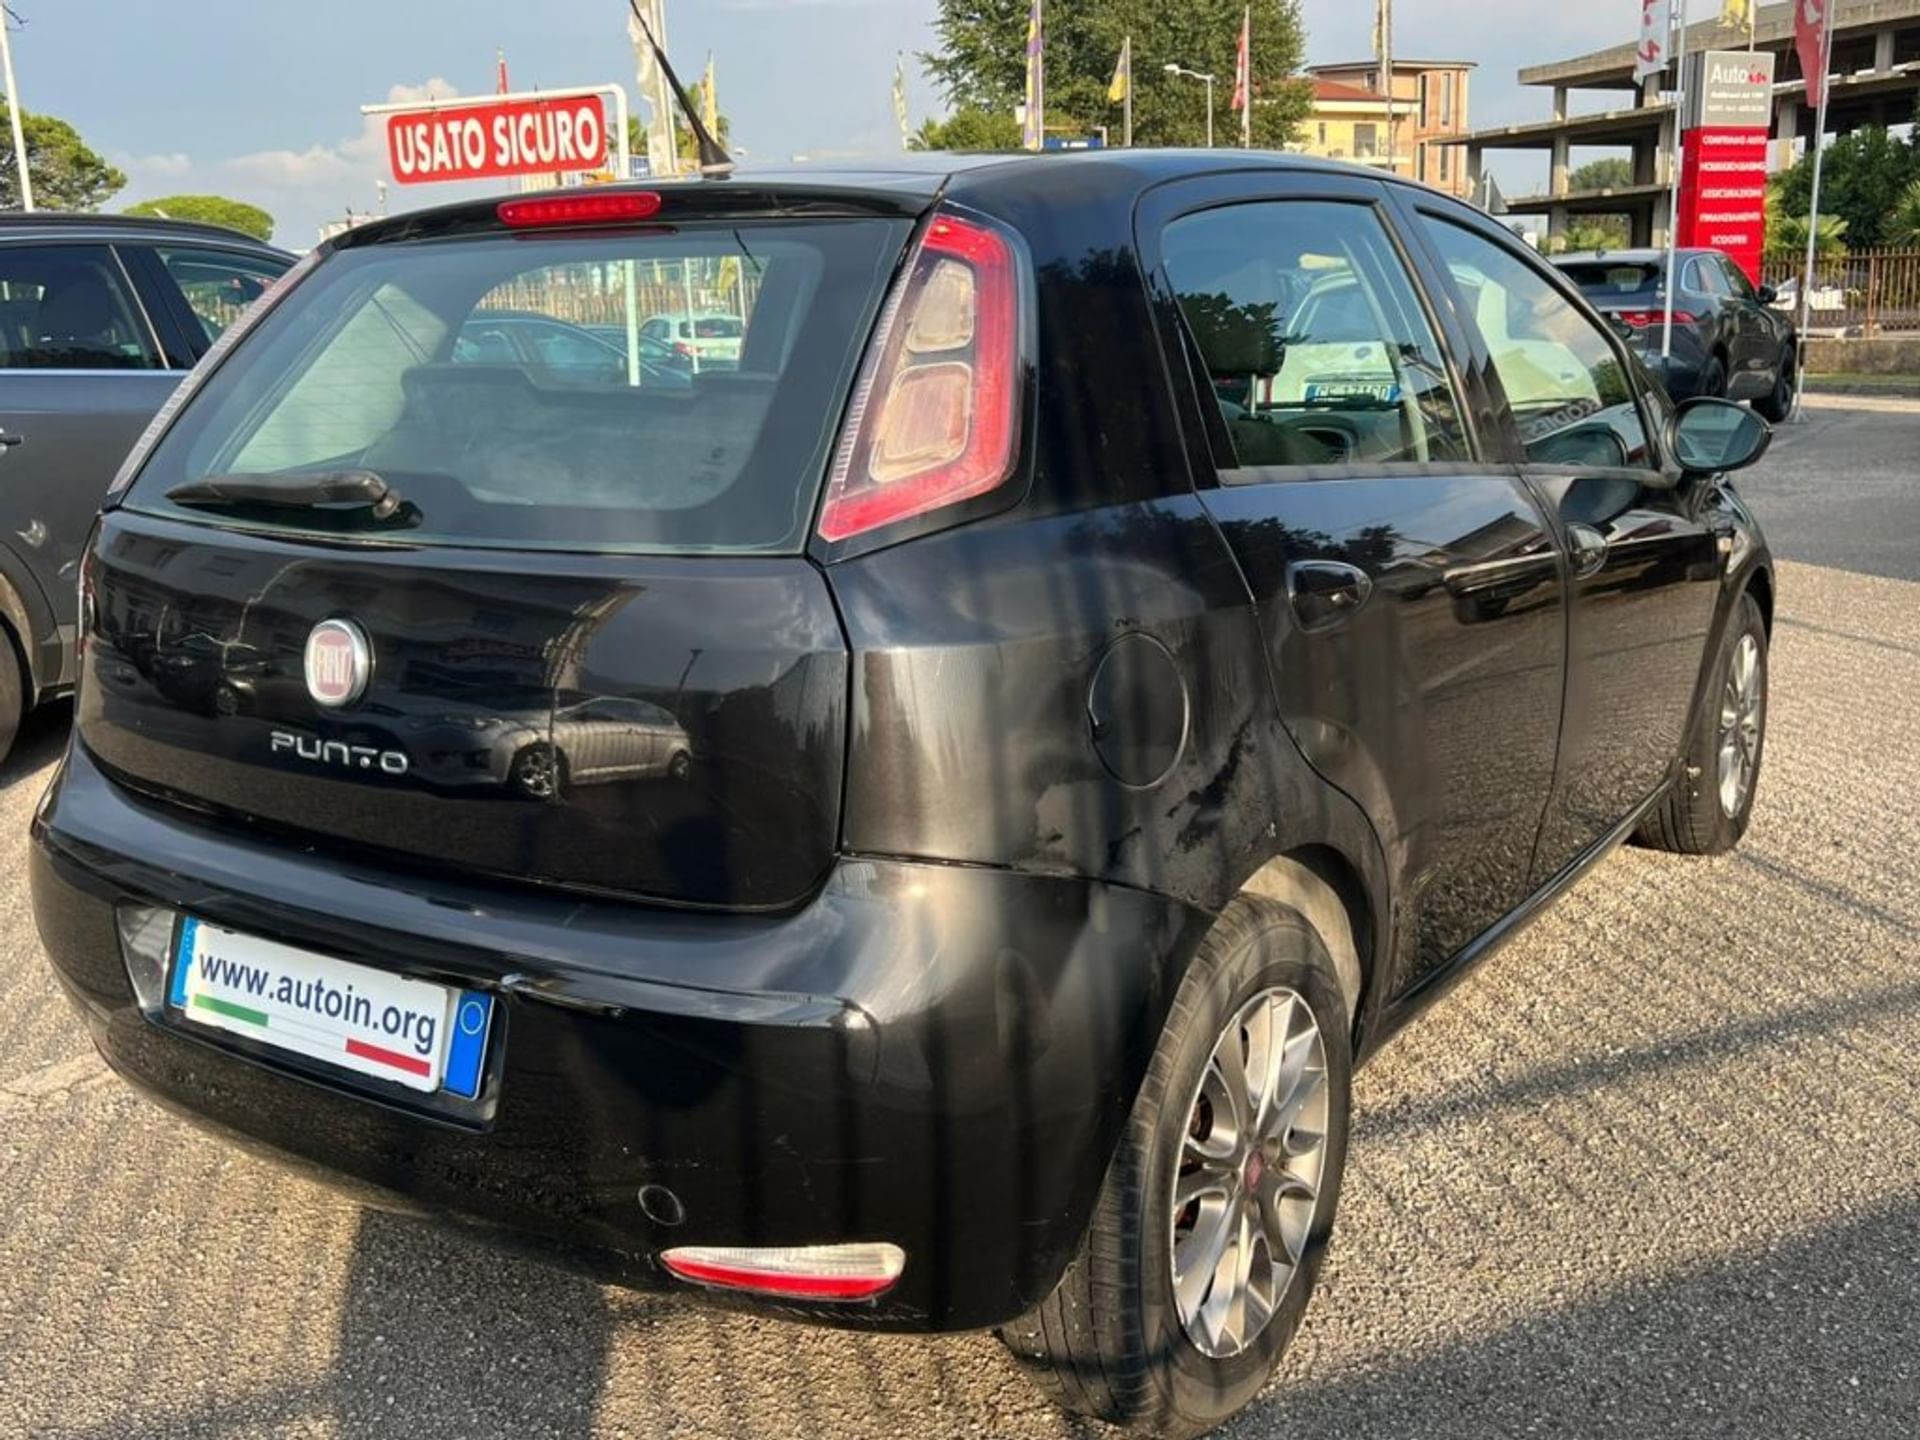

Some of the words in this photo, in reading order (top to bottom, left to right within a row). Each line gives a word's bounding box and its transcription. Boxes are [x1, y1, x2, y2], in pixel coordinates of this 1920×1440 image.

[393, 117, 486, 175] USATO
[492, 106, 600, 167] SICURO
[270, 731, 409, 775] PUNTO
[198, 951, 436, 1055] www.autoin.org
